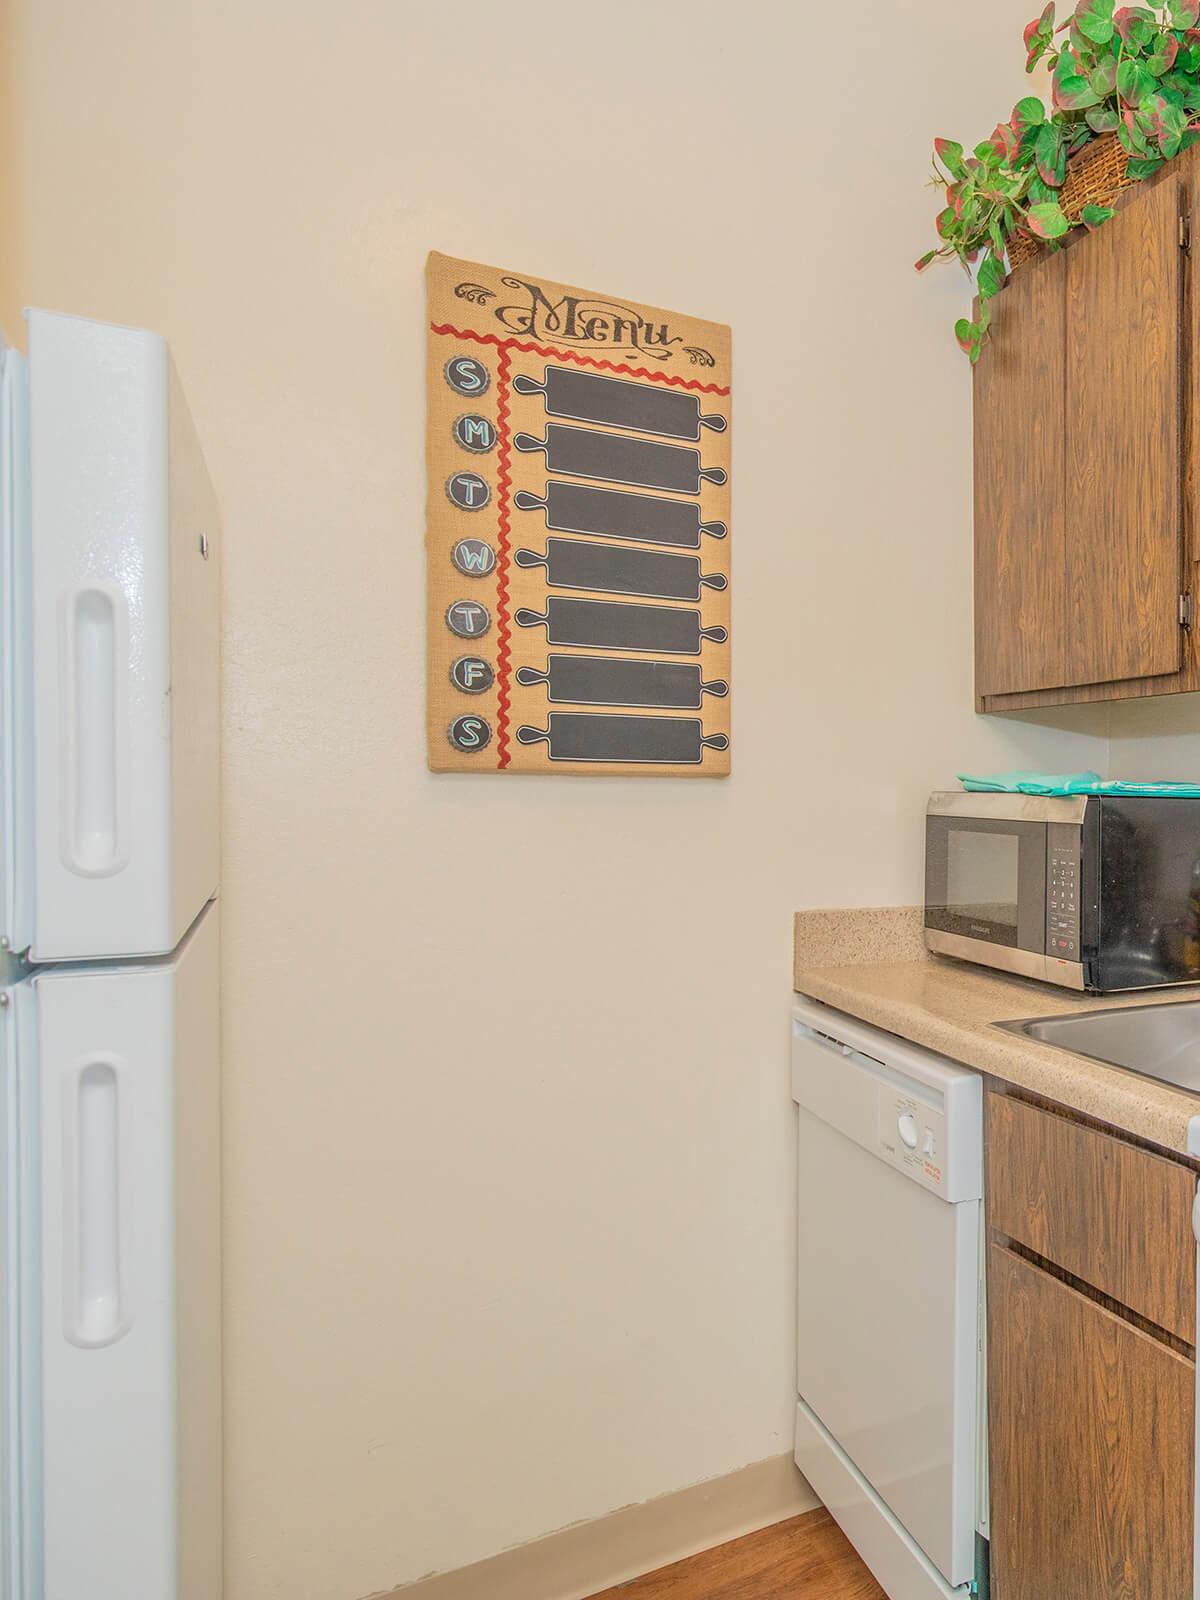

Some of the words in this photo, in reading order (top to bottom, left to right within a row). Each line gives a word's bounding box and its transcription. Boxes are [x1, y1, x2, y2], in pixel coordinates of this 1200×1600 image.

[495, 277, 683, 360] Menu
[456, 361, 481, 389] S
[464, 417, 490, 447] M
[456, 477, 484, 506] T
[460, 544, 488, 571] W
[455, 606, 481, 633] T
[463, 660, 485, 687] F
[458, 719, 482, 747] S
